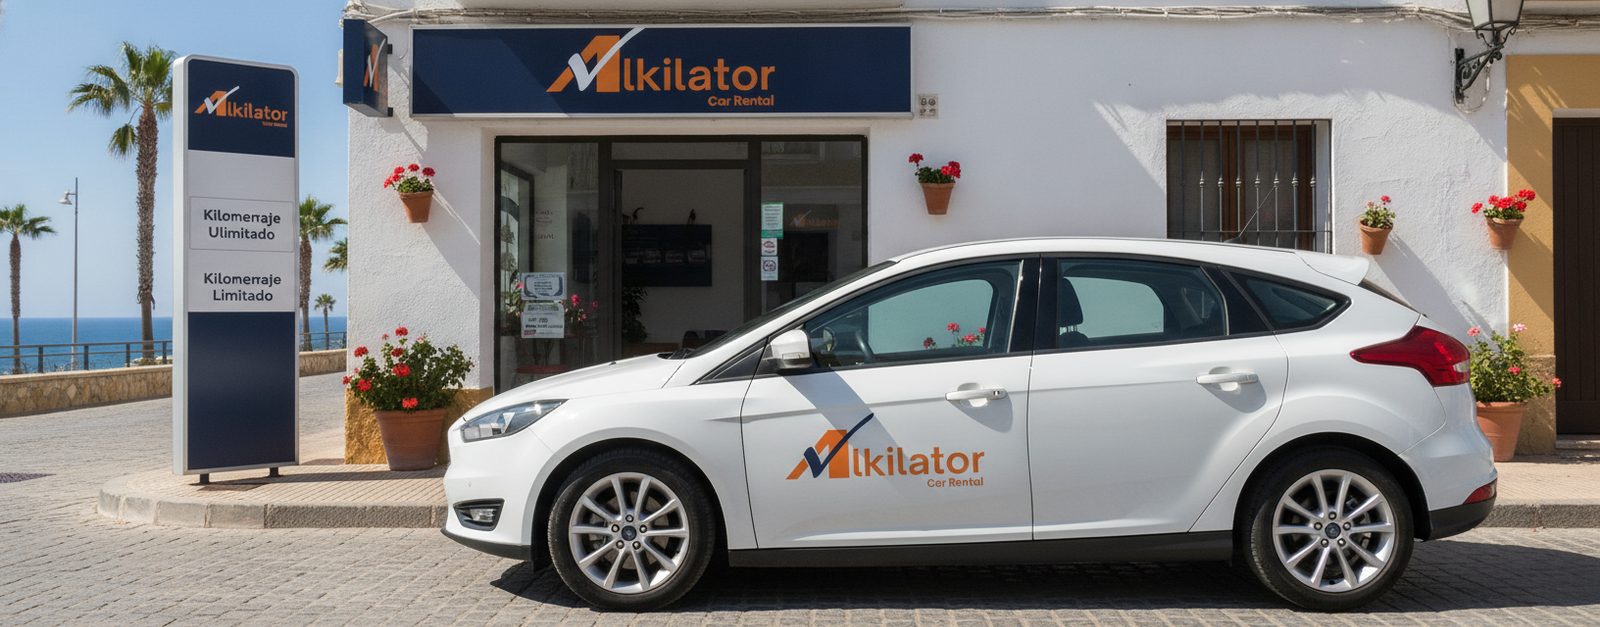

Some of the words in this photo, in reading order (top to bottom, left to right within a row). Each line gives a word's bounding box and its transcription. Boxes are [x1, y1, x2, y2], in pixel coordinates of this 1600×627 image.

[547, 33, 776, 93] Alkilator
[194, 89, 288, 121] Alkilator
[707, 95, 732, 107] Car
[733, 95, 775, 107] Rental
[209, 226, 275, 240] Ulimitado
[213, 289, 274, 302] Limitado
[786, 429, 985, 479] Alkilator
[948, 476, 985, 487] Rental
